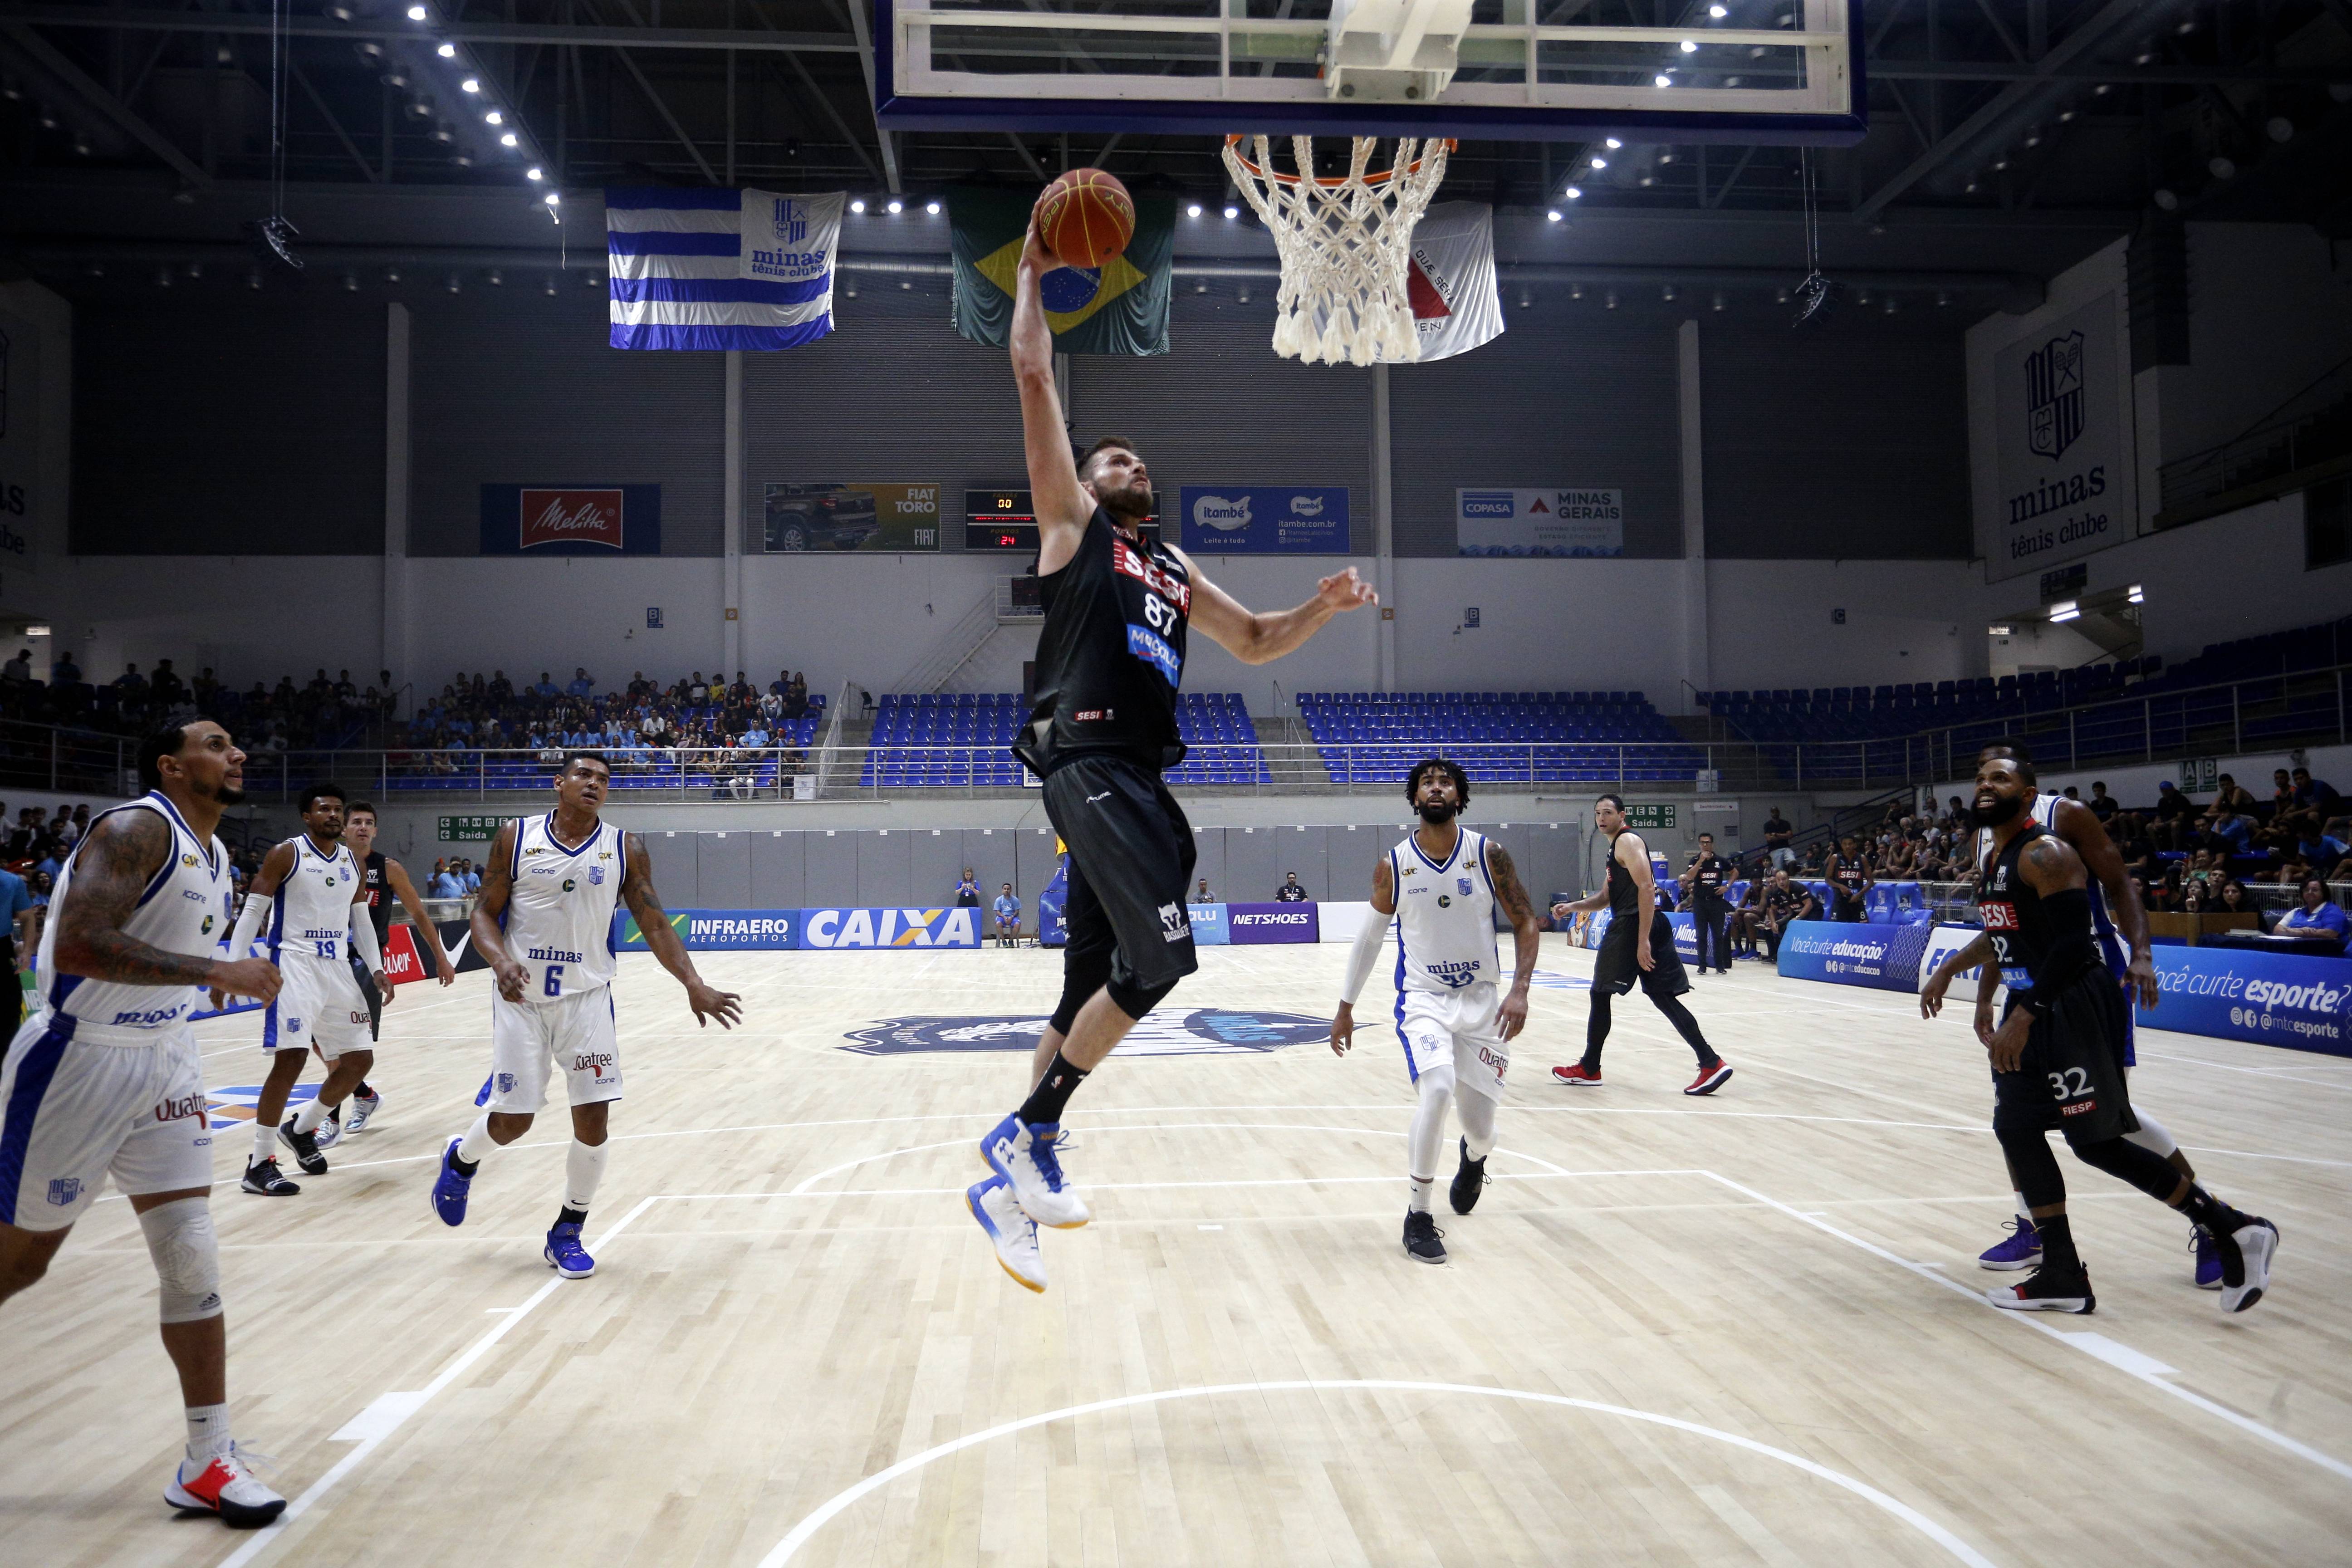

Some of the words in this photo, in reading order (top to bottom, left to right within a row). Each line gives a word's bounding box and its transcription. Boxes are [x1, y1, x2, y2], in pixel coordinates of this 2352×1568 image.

[752, 248, 826, 267] minas
[752, 263, 785, 276] tênis
[789, 265, 824, 277] clube
[908, 488, 936, 500] FIAT
[1558, 493, 1611, 505] MINAS
[2009, 465, 2106, 525] minas
[895, 501, 936, 513] TORO
[998, 499, 1012, 508] 00
[1466, 504, 1510, 513] COPASA
[531, 497, 608, 531] Melitta
[1204, 506, 1245, 519] itambé
[1558, 507, 1620, 519] GERAIS
[914, 529, 936, 545] FIAT
[1001, 536, 1014, 545] 24
[2011, 529, 2054, 559] tênis
[2060, 512, 2108, 544] clube
[1124, 550, 1186, 606] SESI
[1144, 593, 1177, 637] 87
[1077, 711, 1100, 720] SESI
[459, 831, 487, 839] Saída
[182, 853, 201, 868] CVC
[598, 852, 613, 860] CVC
[1402, 867, 1418, 876] CVC
[1462, 861, 1477, 870] CVC
[1233, 913, 1309, 925] NETSHOES
[1860, 911, 1866, 919] 8
[304, 927, 343, 938] minas
[690, 918, 789, 935] INFRAERO
[807, 908, 975, 948] CAIXA
[1163, 924, 1190, 943] BASQUETE
[689, 935, 788, 943] AEROPORTOS
[528, 946, 583, 963] minas
[1791, 936, 1812, 953] Você
[1810, 936, 1832, 955] curte
[1831, 939, 1888, 964] educação?
[1426, 960, 1480, 974] minas
[543, 964, 566, 997] 6
[2188, 970, 2244, 998] curte
[2244, 979, 2352, 1014] esporte?
[351, 1010, 371, 1024] Quat
[1200, 1015, 1285, 1041] STORM
[2260, 1013, 2339, 1039] @mtcesporte
[1479, 1047, 1509, 1072] Quatre
[1494, 1078, 1505, 1089] icon
[2048, 1066, 2095, 1100] 32
[2062, 1101, 2092, 1115] FIESP
